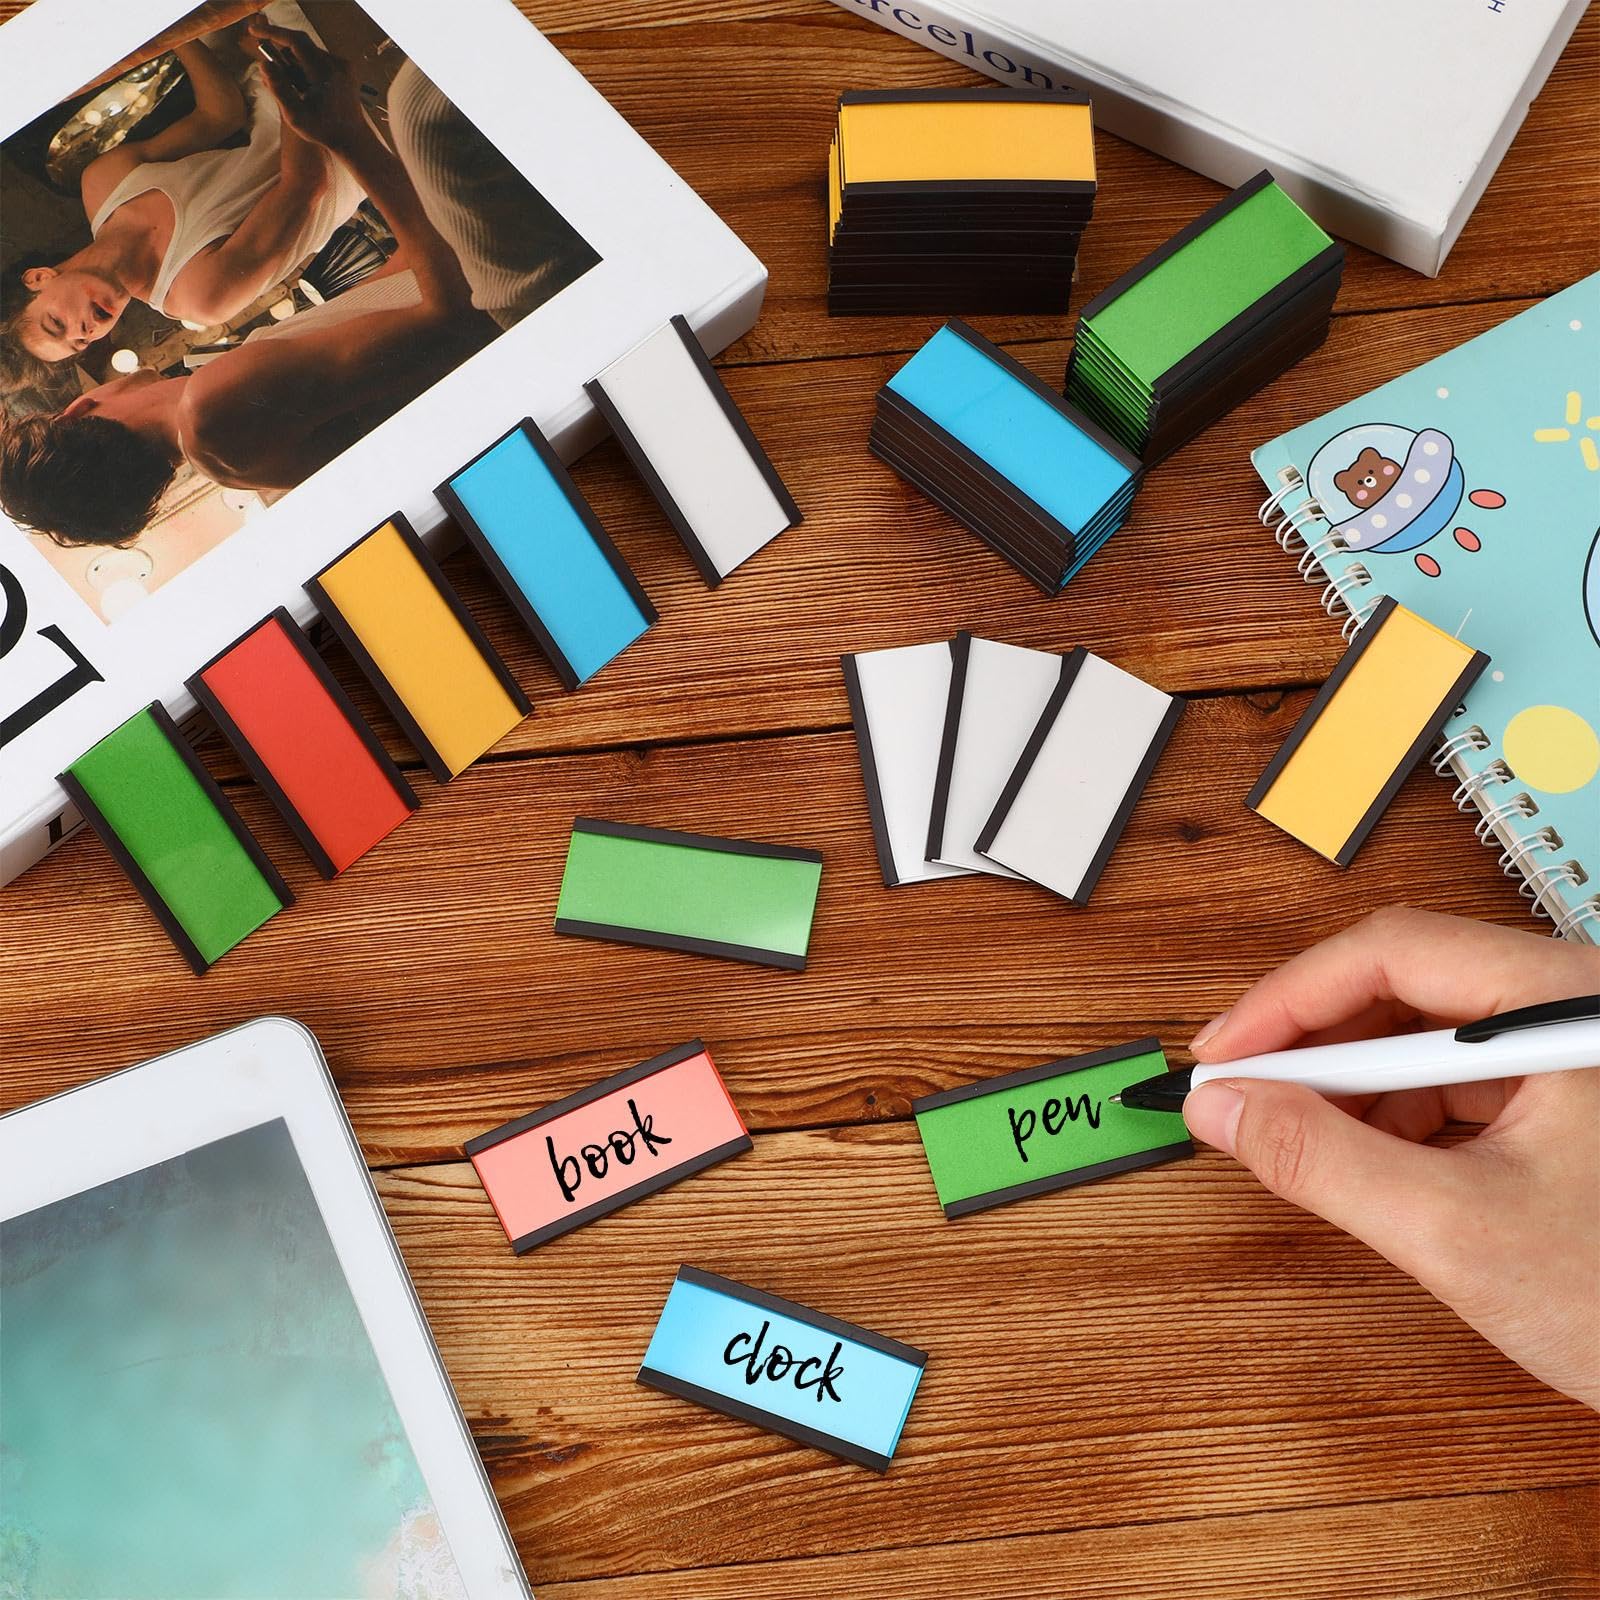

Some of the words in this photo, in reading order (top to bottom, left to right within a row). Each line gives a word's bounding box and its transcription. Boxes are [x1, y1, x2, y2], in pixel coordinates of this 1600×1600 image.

[854, 0, 1077, 93] rcelon
[546, 1099, 672, 1202] book
[1008, 1093, 1102, 1162] pen
[724, 1321, 843, 1403] clock
